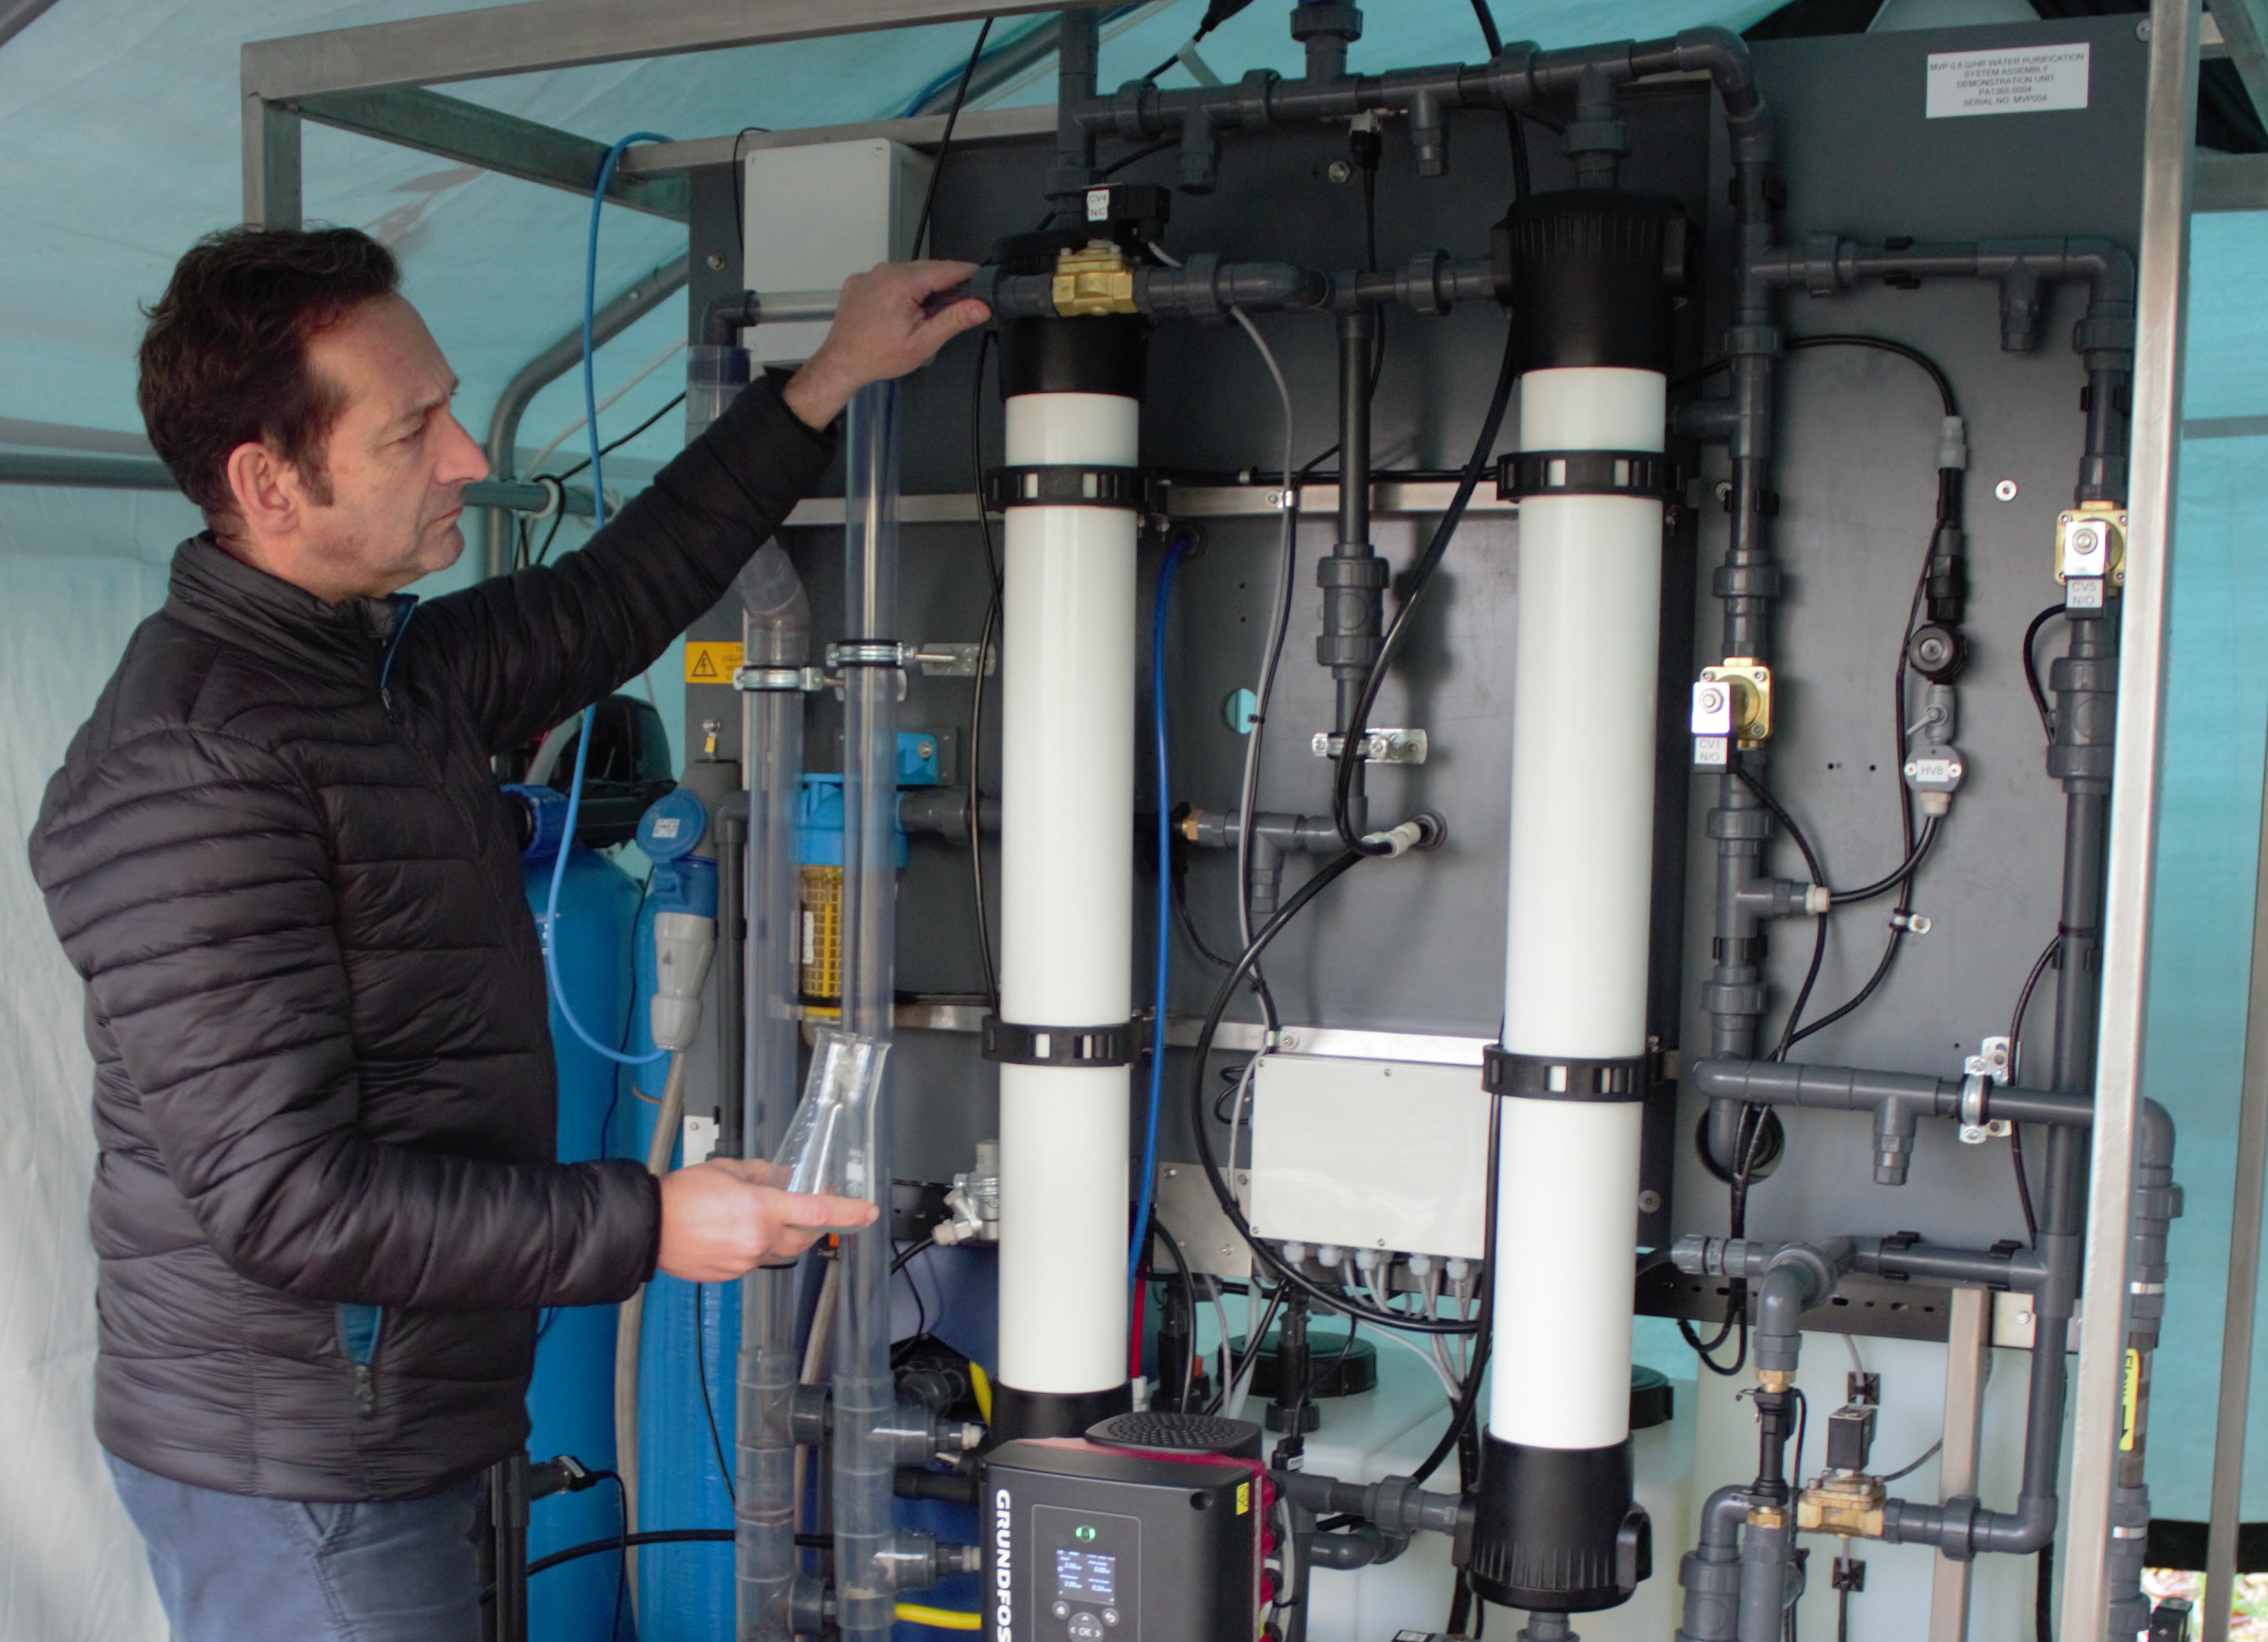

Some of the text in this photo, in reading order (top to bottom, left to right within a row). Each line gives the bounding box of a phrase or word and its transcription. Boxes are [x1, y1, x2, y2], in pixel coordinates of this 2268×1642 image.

[1930, 62, 1948, 71] MVP
[1988, 58, 2020, 66] WATER
[2022, 53, 2084, 64] PURIFICATION
[1964, 65, 2048, 78] SYSTEM ASSEMBLY
[1957, 74, 2055, 88] DEMONSTRATION UNIT
[1963, 98, 1992, 107] SERIAL
[1090, 194, 1107, 202] CV4
[2072, 581, 2096, 592] CV5
[2073, 596, 2094, 606] N/O
[1700, 739, 1720, 749] CV1
[1700, 752, 1719, 762] N/O
[1922, 765, 1944, 776] HV8
[996, 1489, 1012, 1642] GRUNDFOS
[1078, 1627, 1092, 1637] OK
